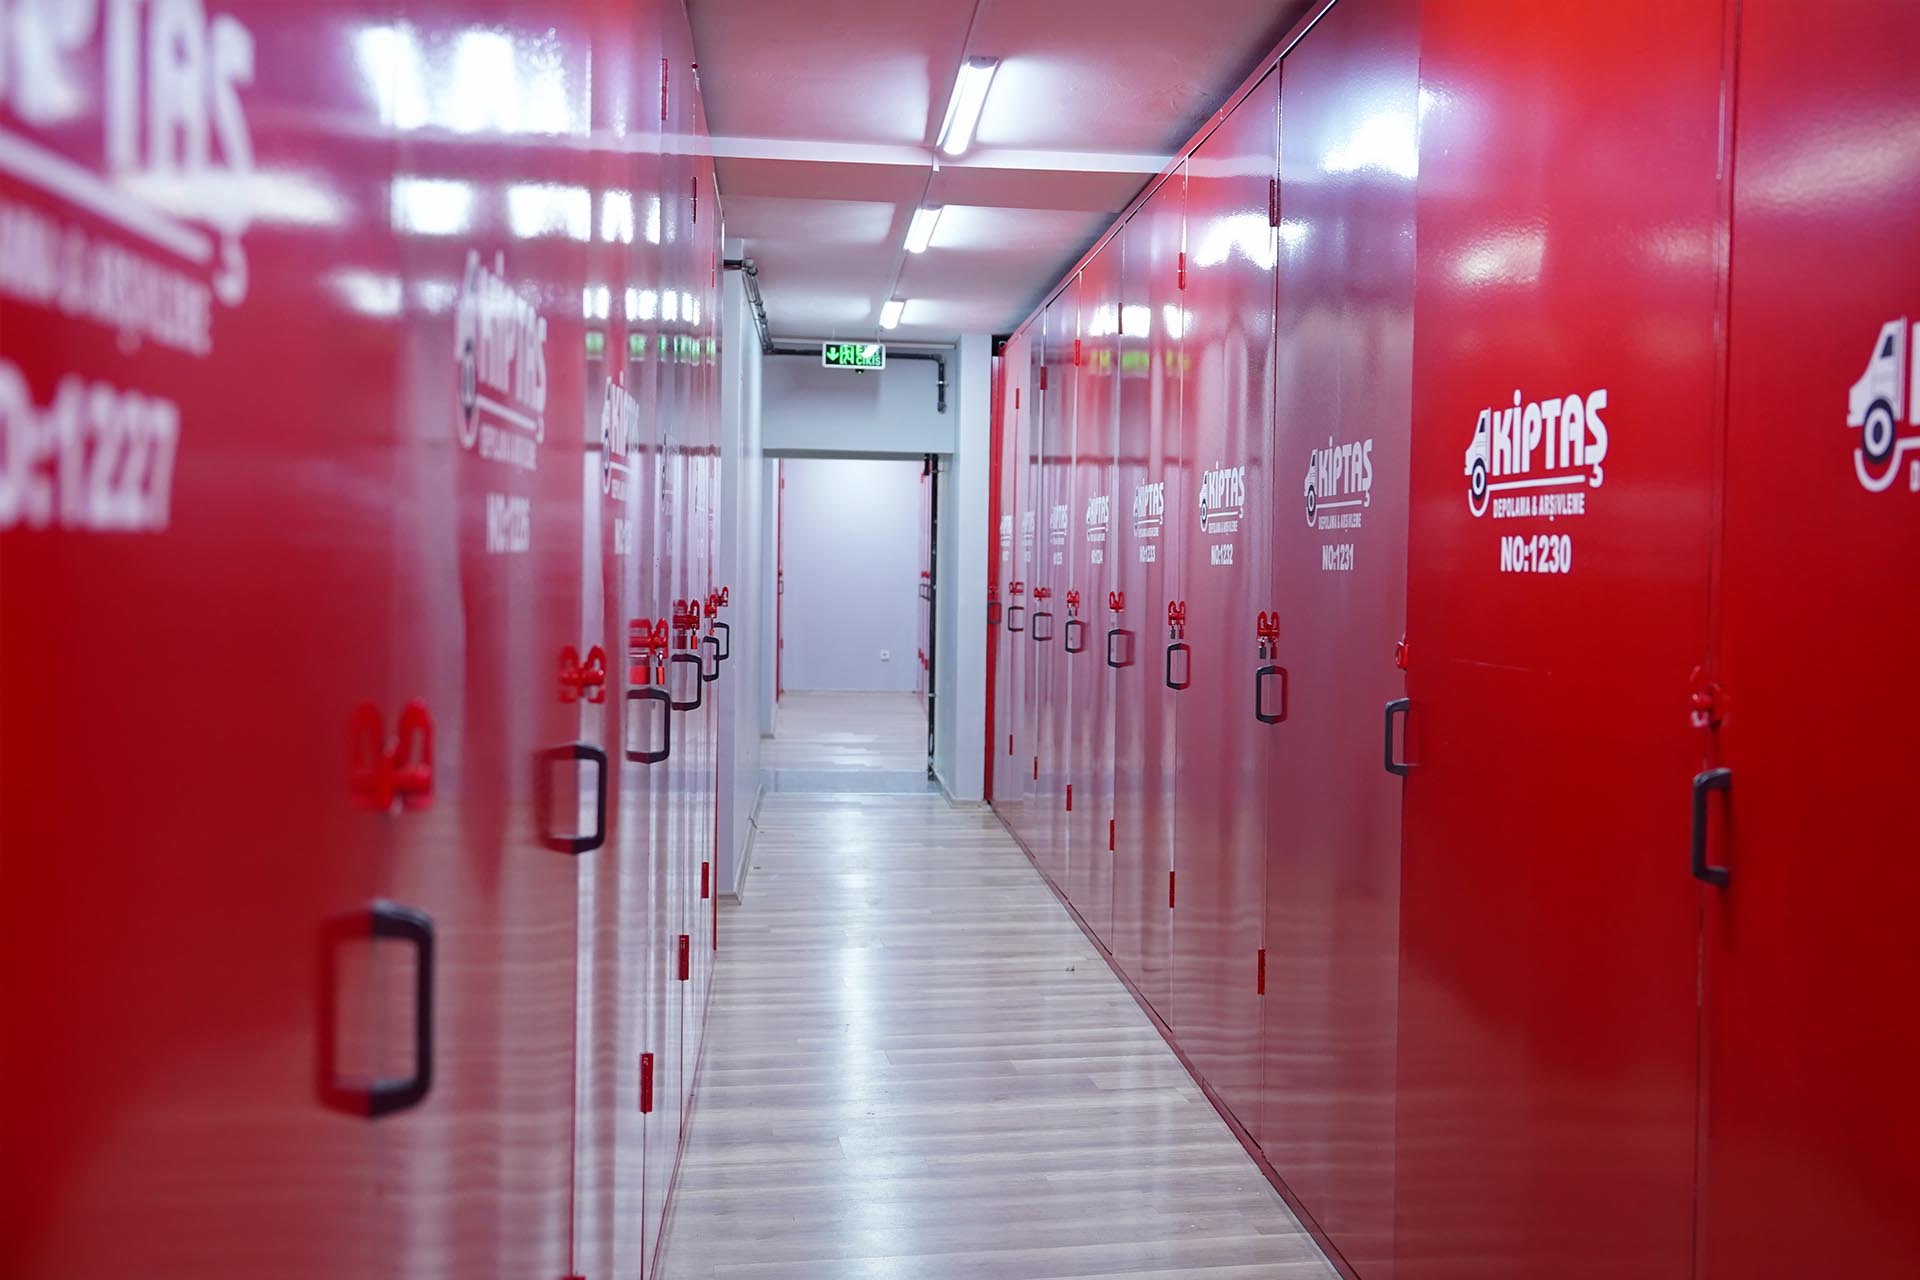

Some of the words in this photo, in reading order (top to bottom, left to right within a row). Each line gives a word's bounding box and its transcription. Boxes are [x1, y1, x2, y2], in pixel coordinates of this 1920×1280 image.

[0, 358, 181, 532] O:1227
[1492, 388, 1608, 489] KİPTAŞ
[1207, 460, 1246, 519] KİPTAŞ
[1318, 436, 1373, 507] KİPTAŞ
[1493, 496, 1531, 519] DEPOLAMA
[1321, 543, 1354, 571] NO:1231
[1500, 533, 1572, 574] NO:1230
